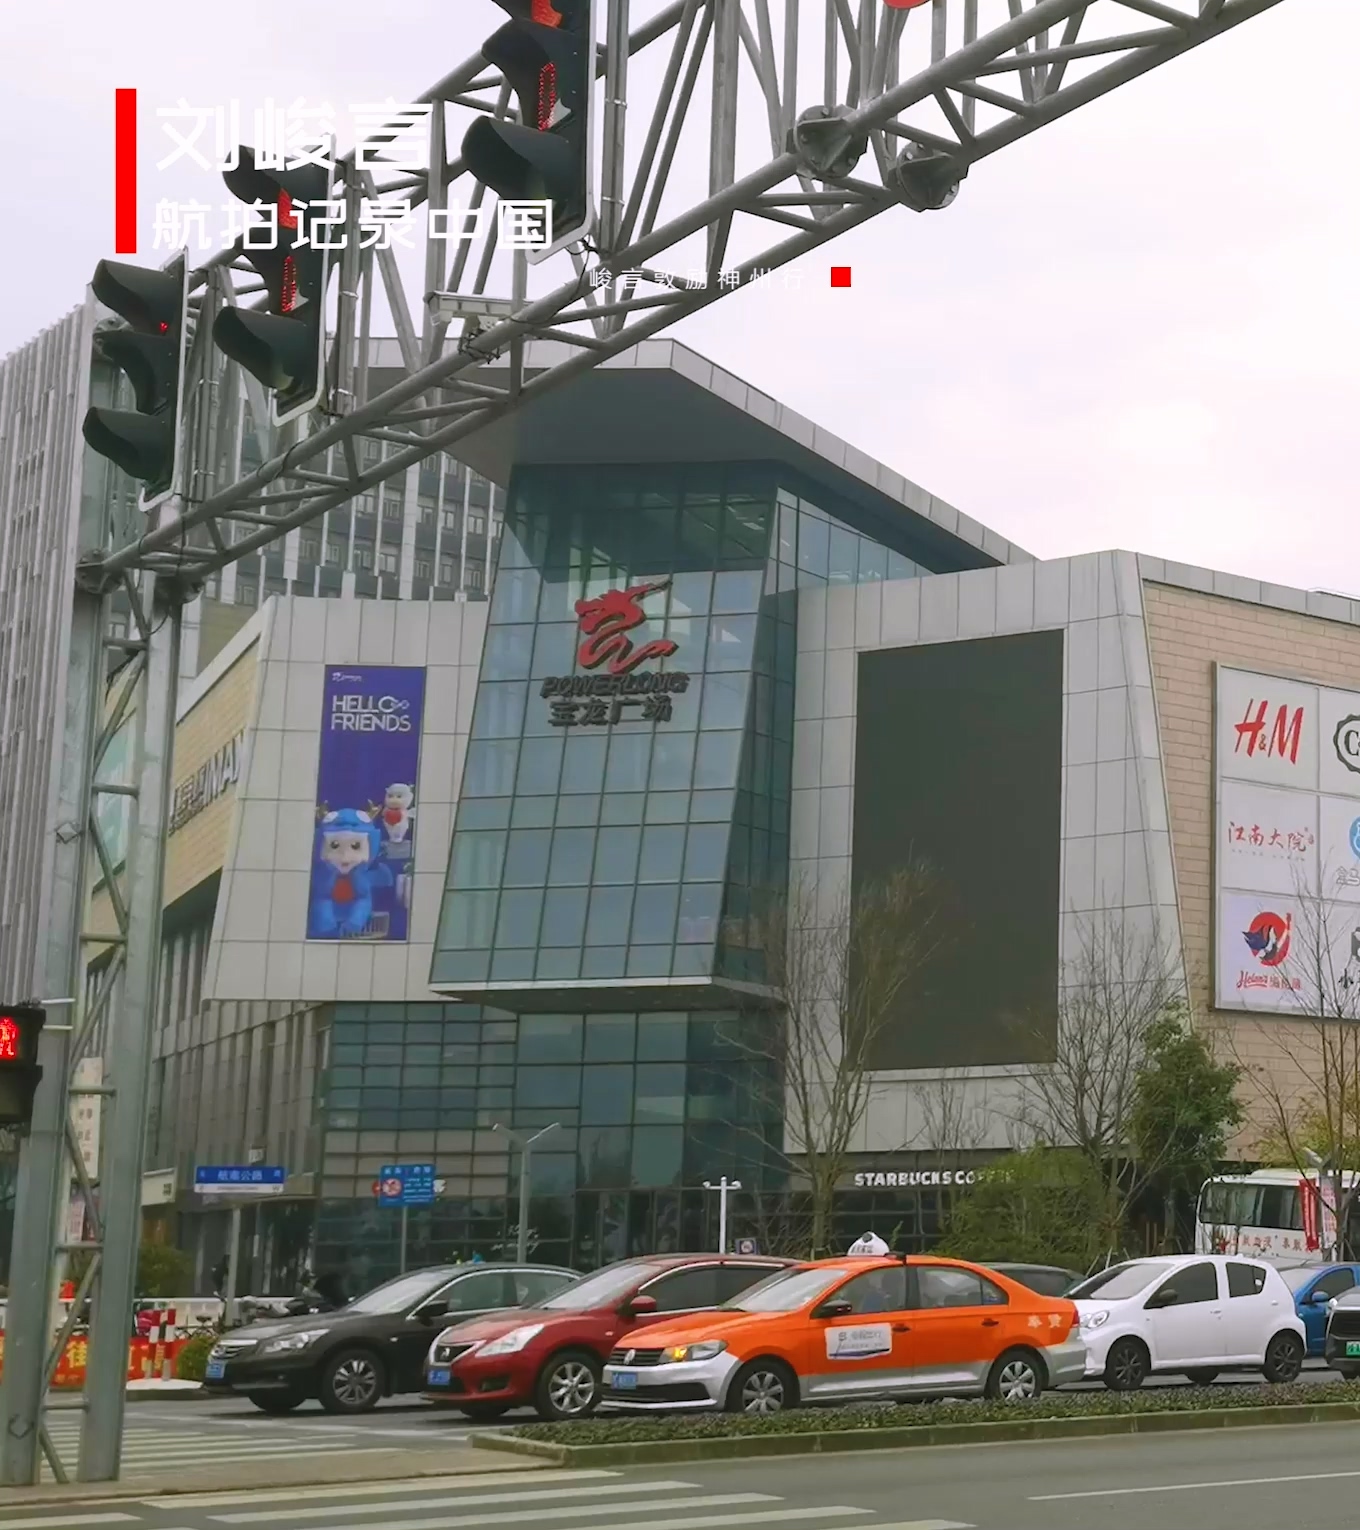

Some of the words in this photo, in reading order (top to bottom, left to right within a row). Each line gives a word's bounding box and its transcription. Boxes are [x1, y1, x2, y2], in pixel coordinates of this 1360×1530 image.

[540, 671, 690, 698] POWERLONG
[332, 695, 410, 713] HELLO
[548, 695, 672, 726] 宝龙广场
[331, 713, 411, 732] FRIENDS
[1234, 698, 1304, 765] H&M
[1228, 821, 1306, 852] 江南大院
[854, 1171, 952, 1187] STARBUCKS
